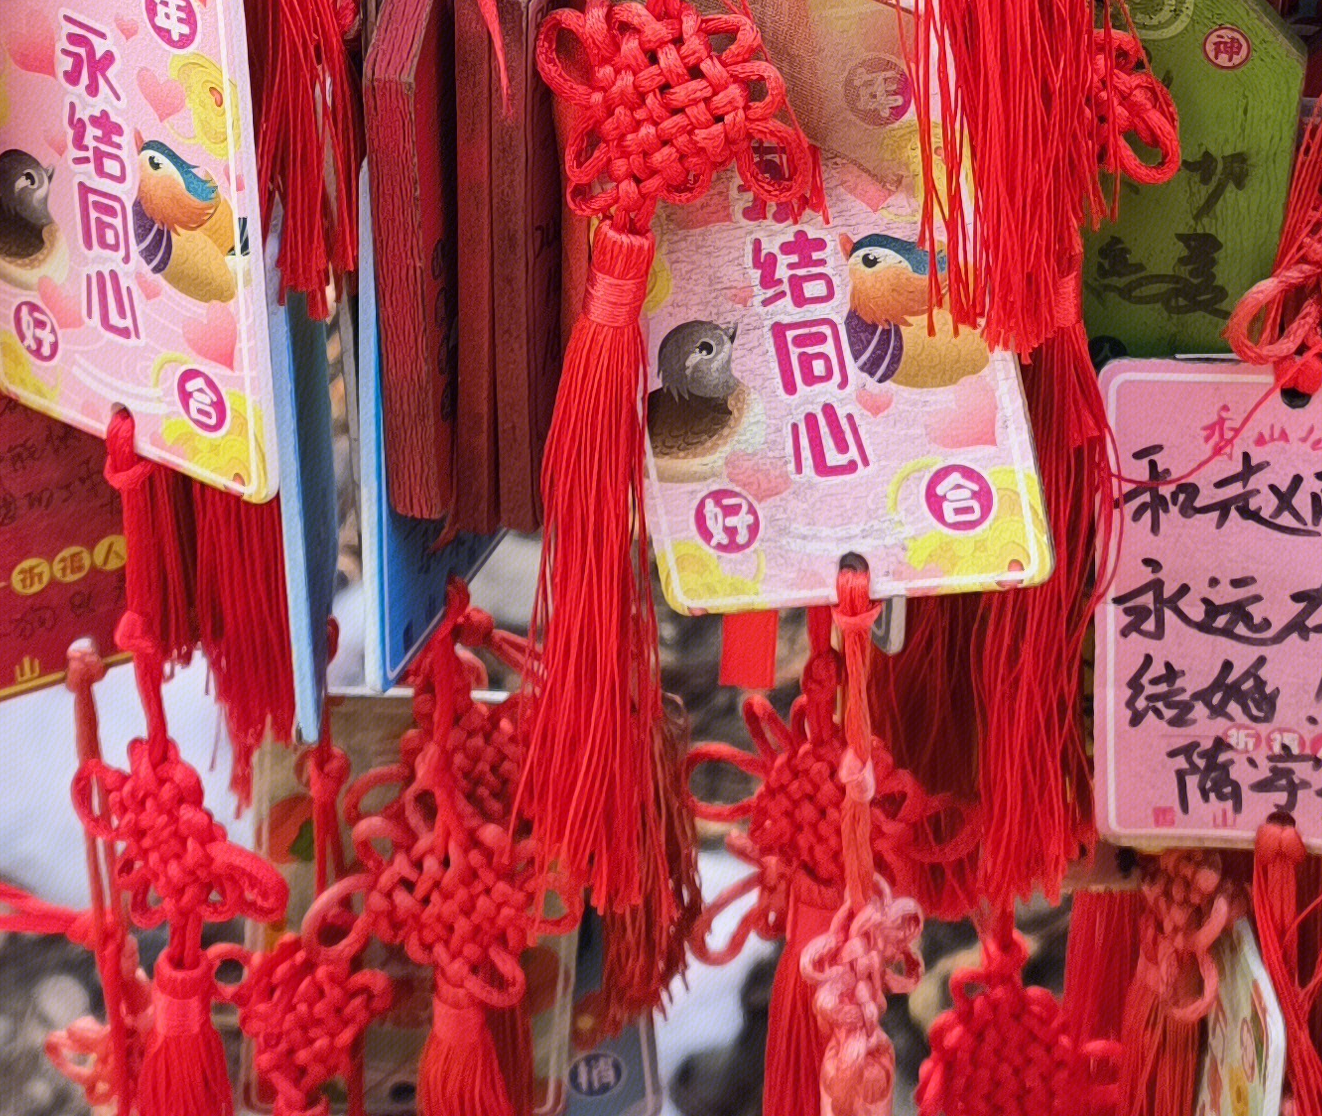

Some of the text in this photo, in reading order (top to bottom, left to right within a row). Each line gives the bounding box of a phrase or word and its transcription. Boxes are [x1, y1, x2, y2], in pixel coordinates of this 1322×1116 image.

[1212, 33, 1244, 65] 神
[60, 11, 141, 344] 永结同心
[18, 305, 57, 357] 好
[183, 375, 222, 430] 合
[702, 497, 755, 548] 好
[933, 470, 983, 526] 合
[15, 537, 126, 594] 祈福人
